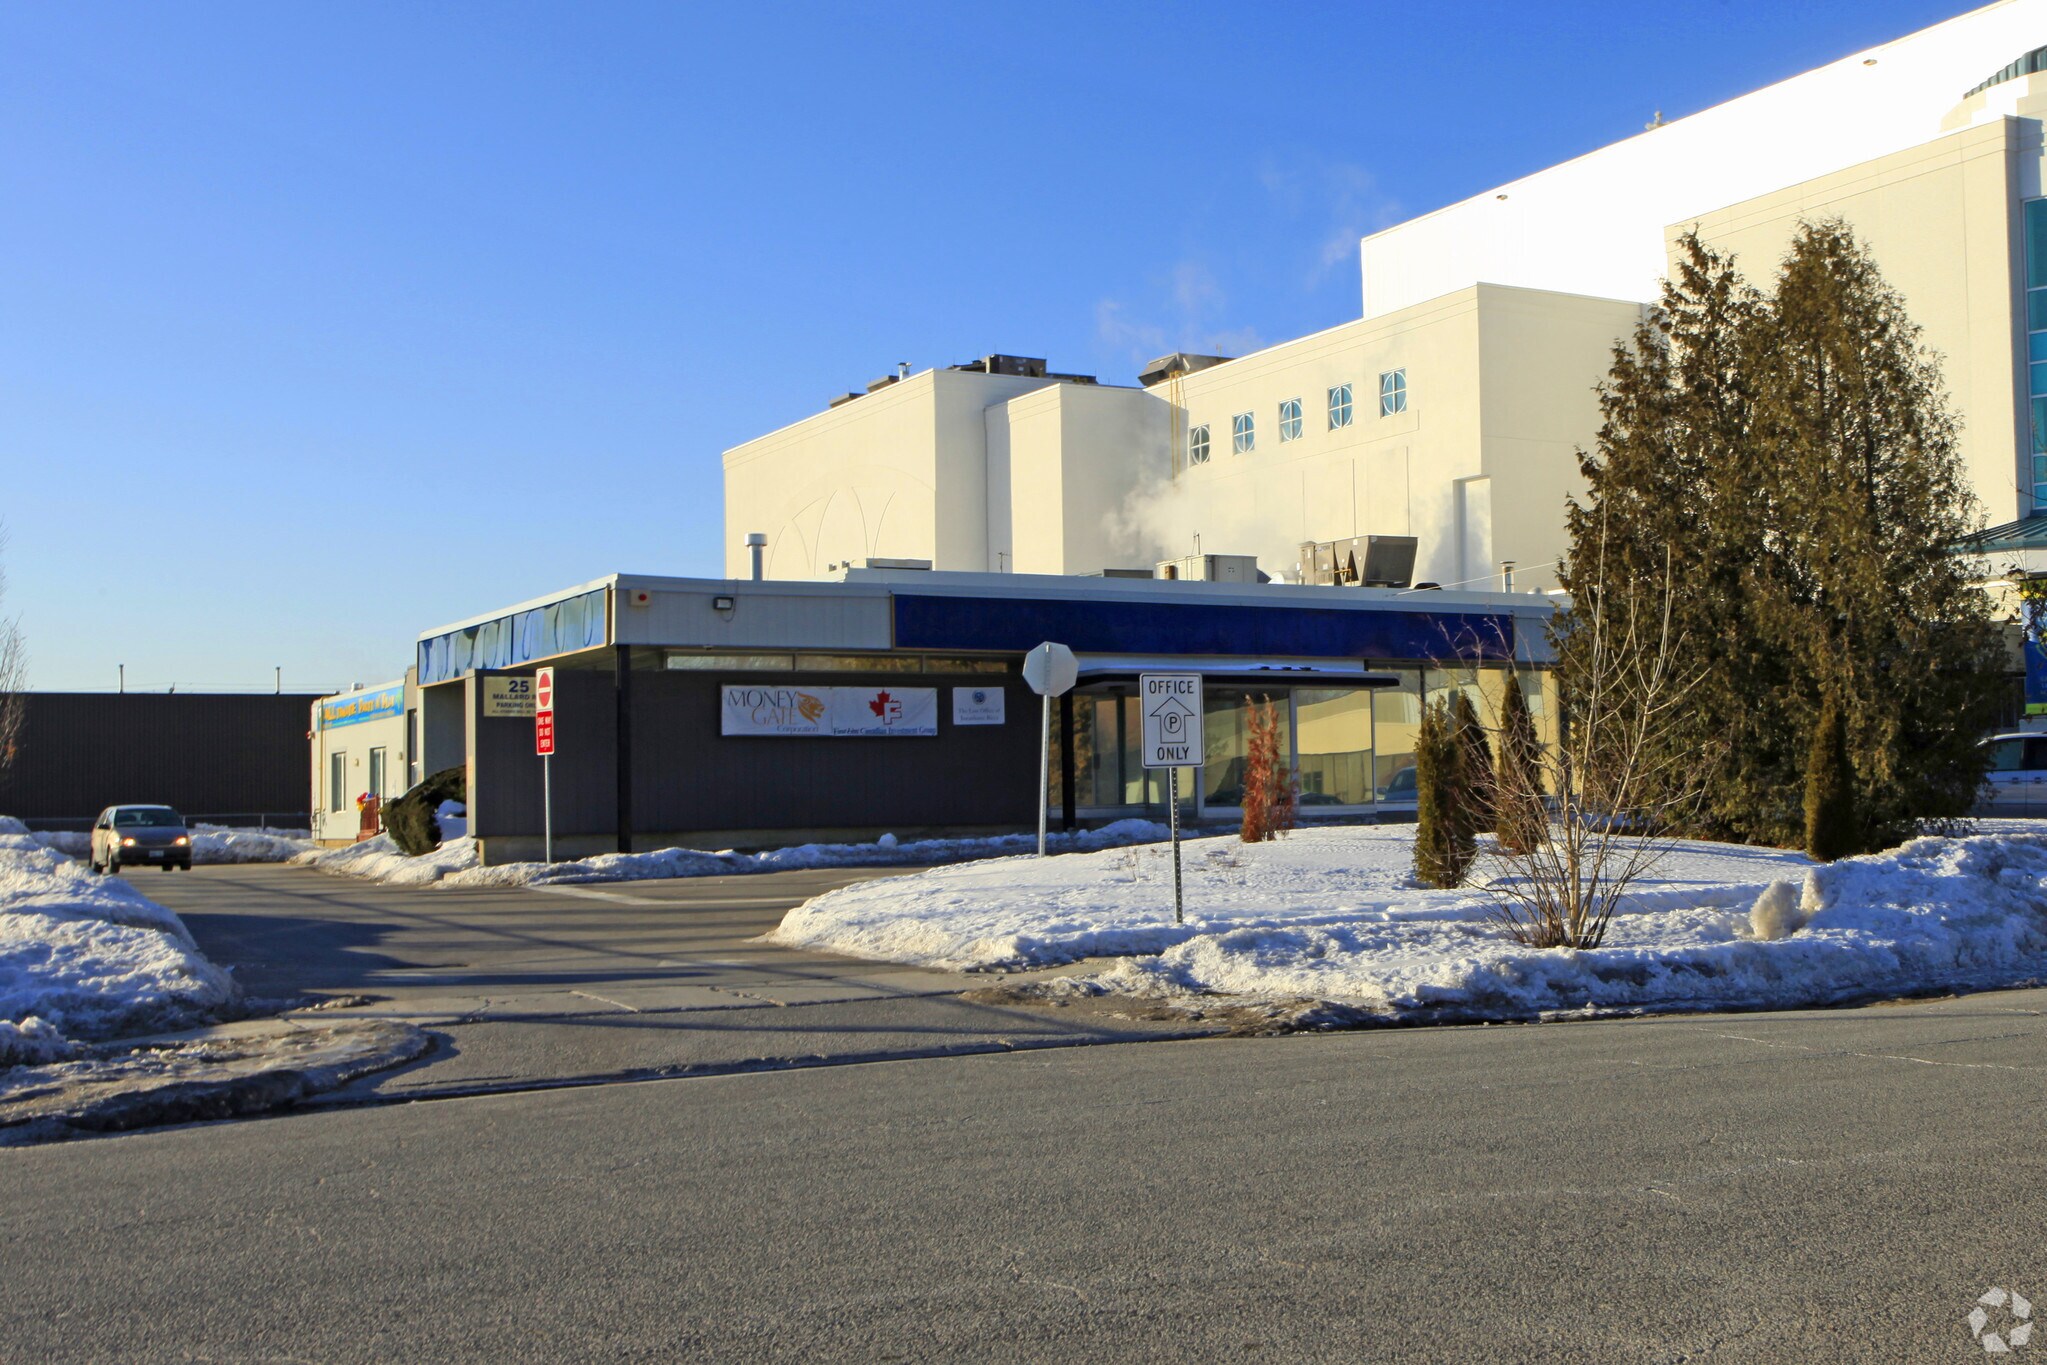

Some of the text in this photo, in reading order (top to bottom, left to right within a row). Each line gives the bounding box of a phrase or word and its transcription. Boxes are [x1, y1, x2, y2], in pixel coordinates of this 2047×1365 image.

[508, 680, 529, 693] 25
[1149, 680, 1194, 694] OFFICE
[728, 689, 798, 708] MONEY
[752, 706, 798, 725] GATE
[1169, 716, 1178, 729] P
[777, 725, 819, 734] Corporation
[888, 727, 918, 735] Investment
[919, 727, 937, 736] Group
[1157, 747, 1190, 760] ONLY
